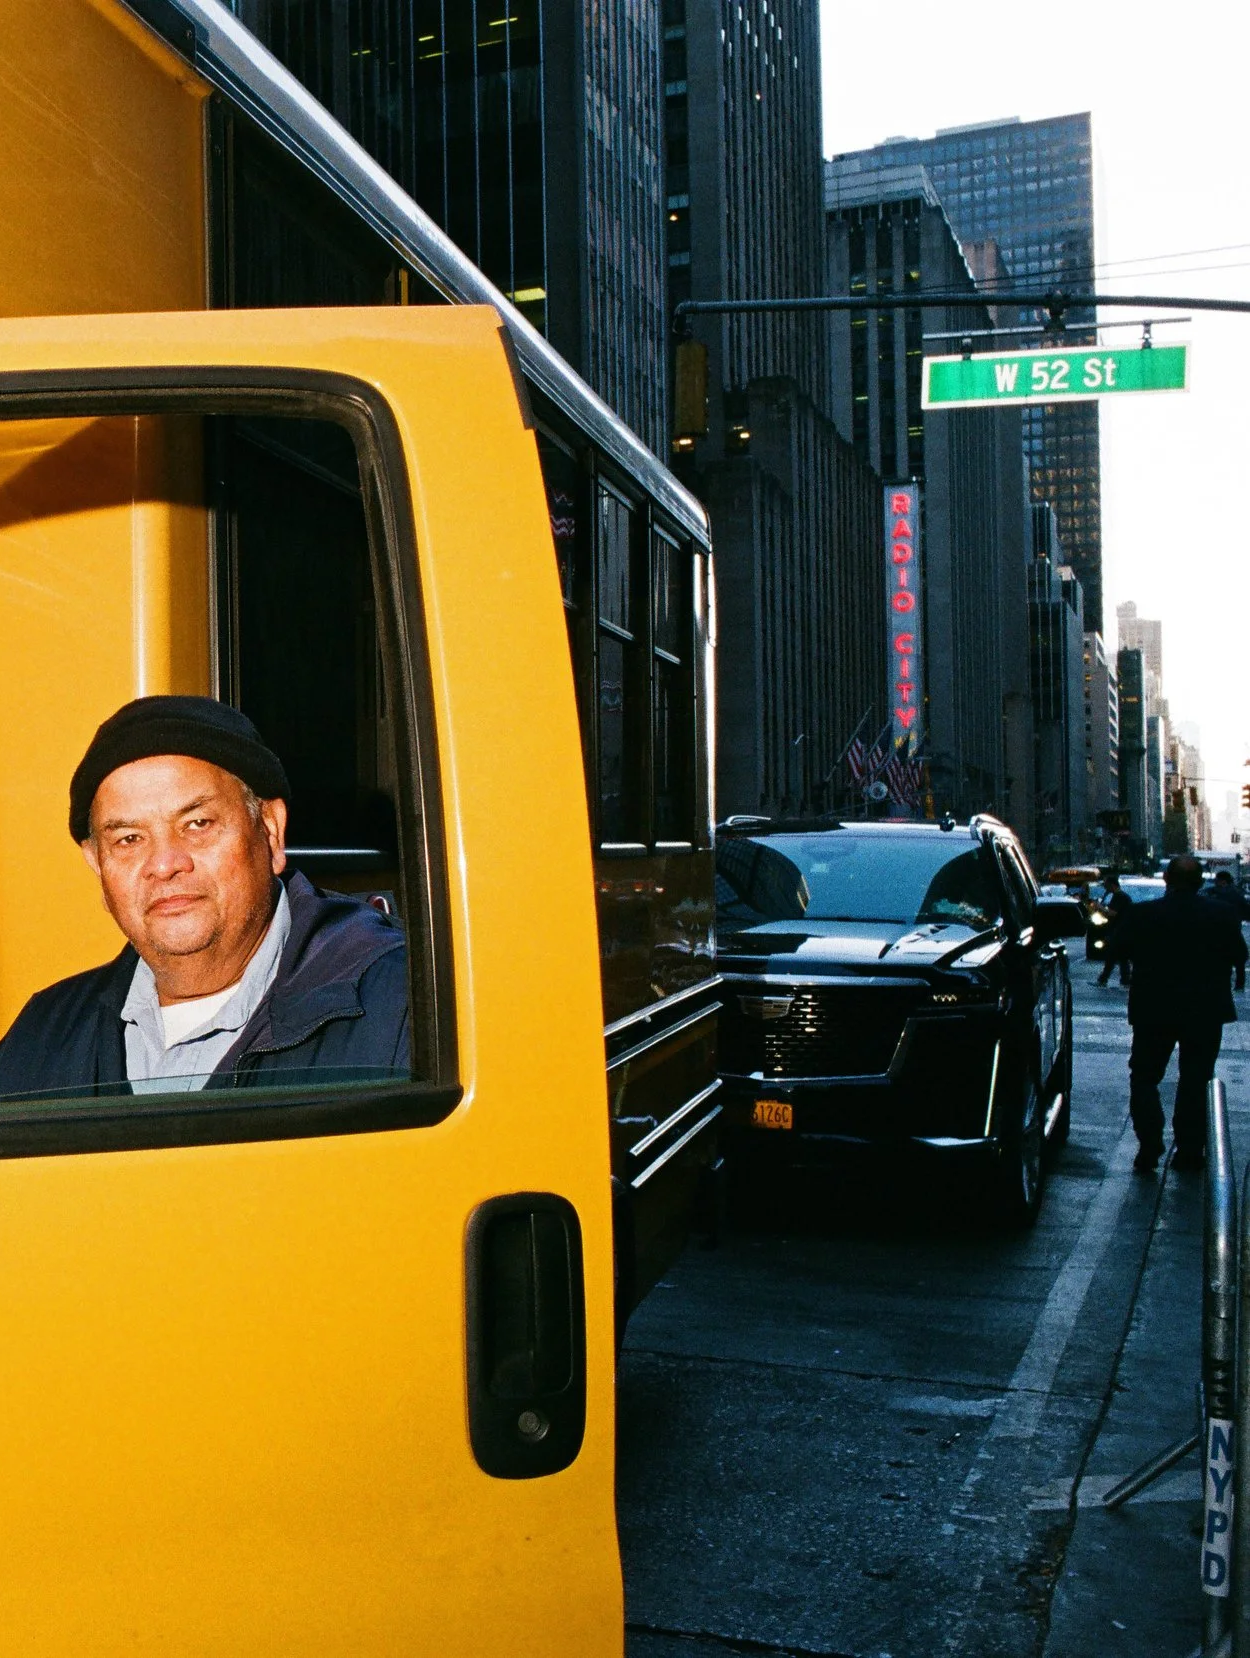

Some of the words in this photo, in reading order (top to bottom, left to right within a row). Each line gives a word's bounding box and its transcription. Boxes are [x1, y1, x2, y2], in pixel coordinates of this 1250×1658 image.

[994, 362, 1019, 393] W
[1031, 359, 1070, 391] 52
[1083, 357, 1117, 388] St
[891, 493, 916, 614] RADIO
[893, 632, 917, 729] CITY
[1203, 1425, 1234, 1588] NYPD
